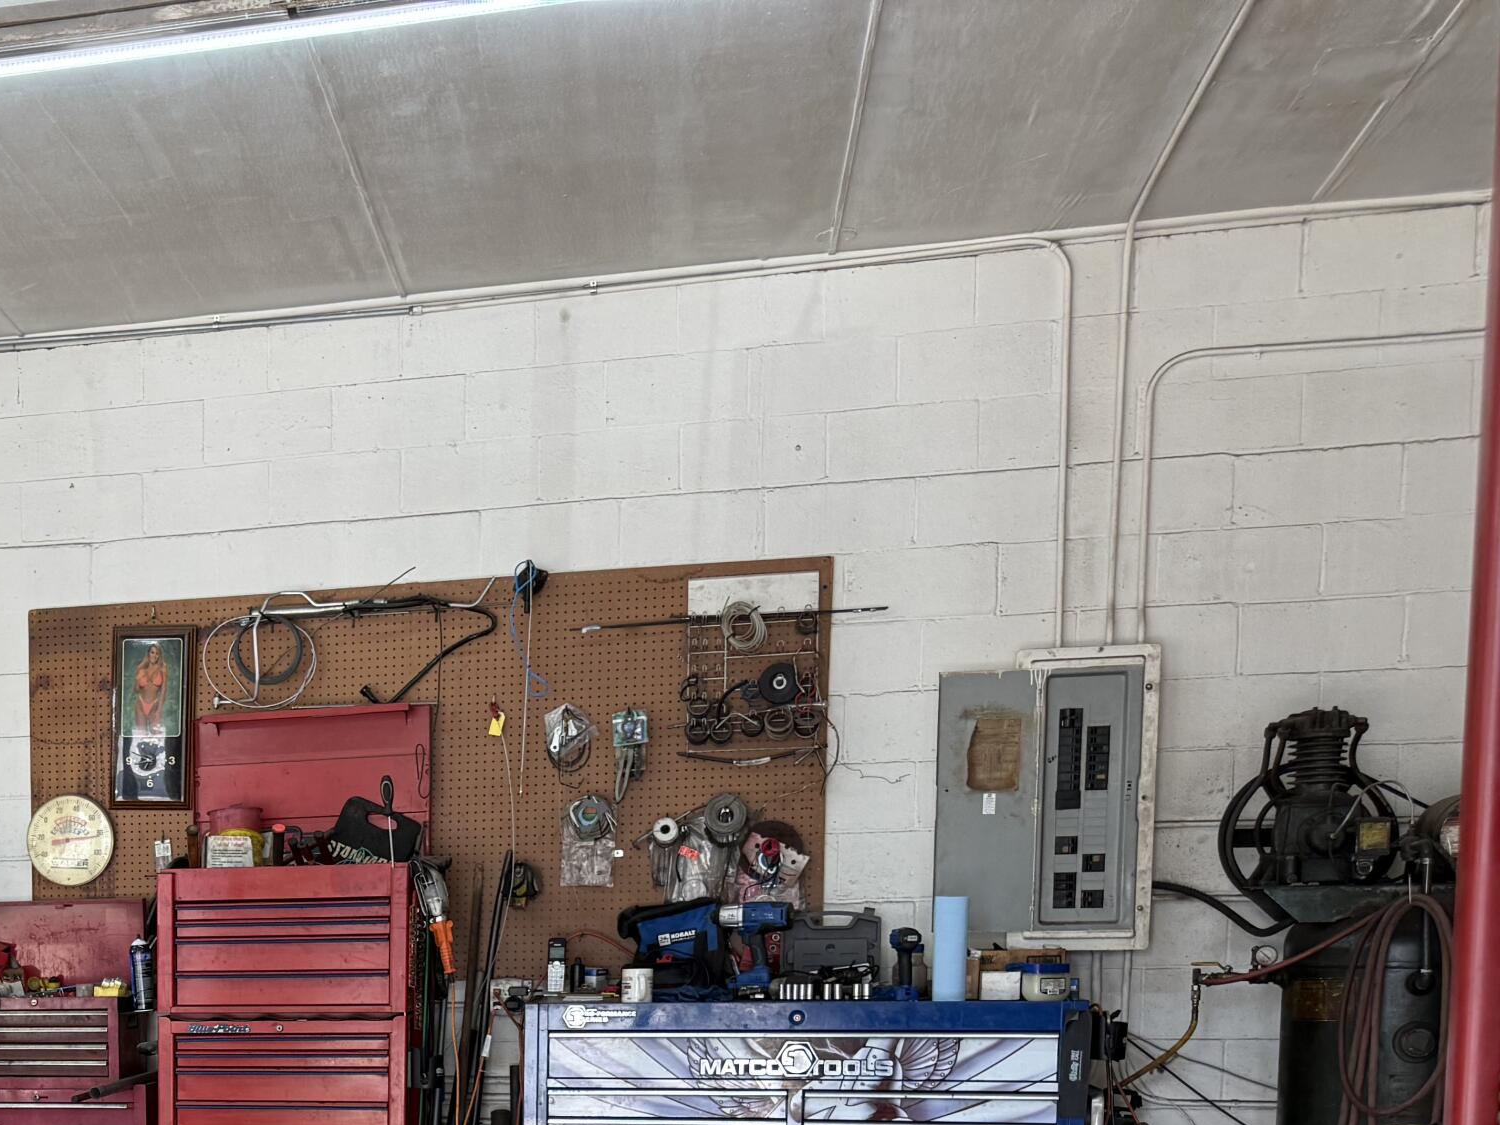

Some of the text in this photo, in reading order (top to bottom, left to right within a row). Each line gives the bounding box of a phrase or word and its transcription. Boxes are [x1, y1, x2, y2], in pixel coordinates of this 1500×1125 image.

[125, 756, 133, 766] 9
[168, 756, 176, 765] 3
[146, 779, 154, 788] 6
[670, 929, 696, 939] KOBALT
[700, 1059, 894, 1077] MATCO TOOLS
